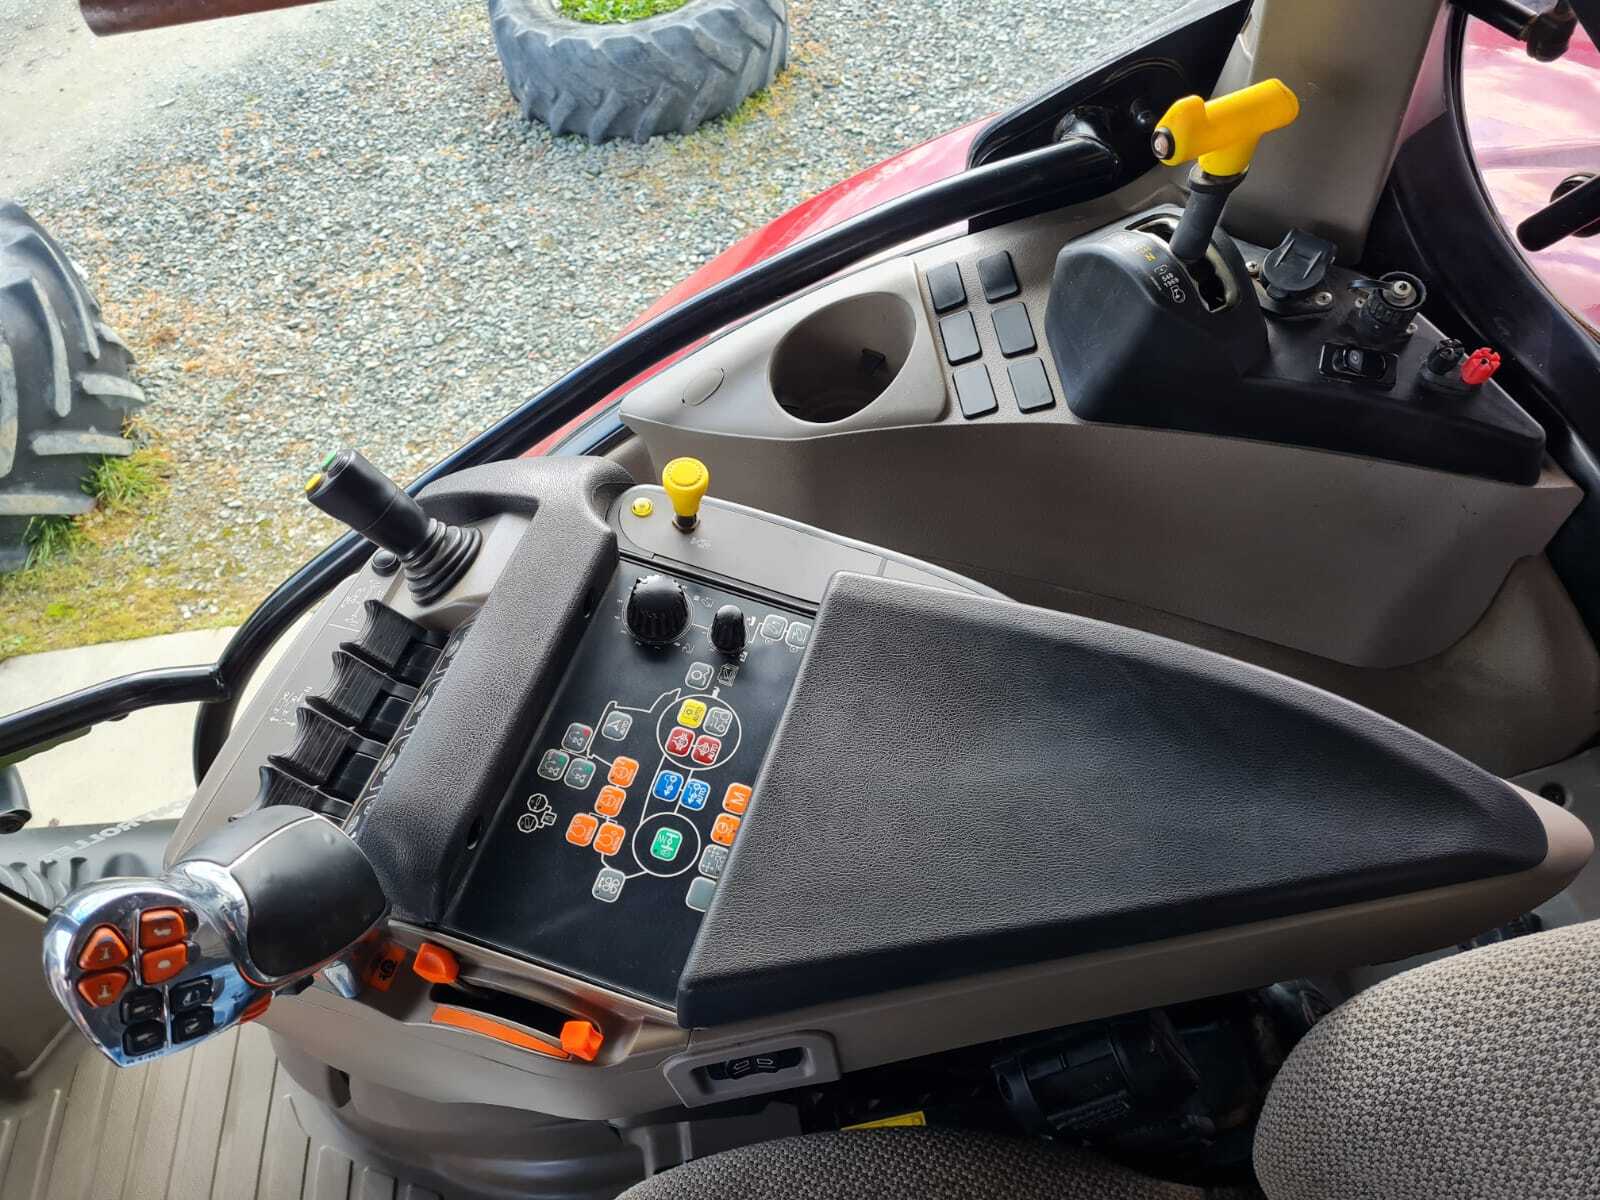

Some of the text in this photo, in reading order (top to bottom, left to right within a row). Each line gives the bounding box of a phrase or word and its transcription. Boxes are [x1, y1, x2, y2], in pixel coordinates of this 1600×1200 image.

[708, 743, 719, 761] AUTO
[696, 787, 706, 805] AUTO
[731, 792, 746, 805] M
